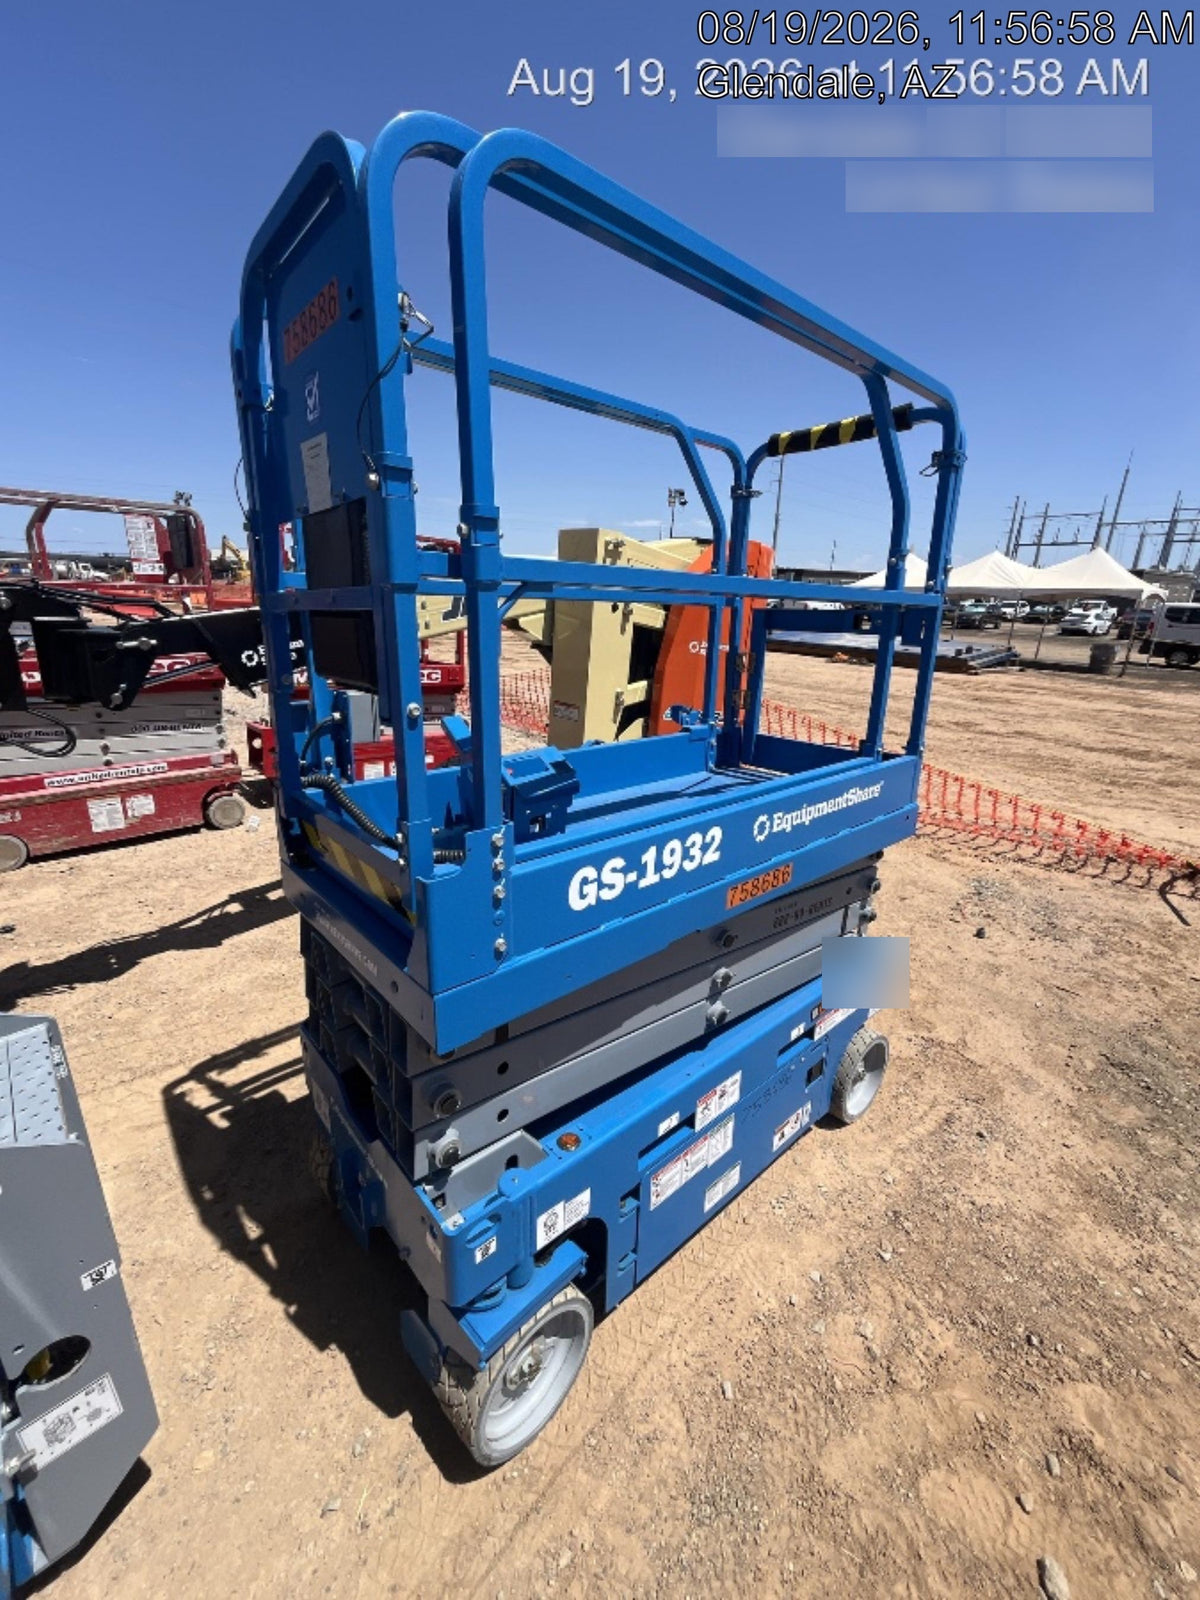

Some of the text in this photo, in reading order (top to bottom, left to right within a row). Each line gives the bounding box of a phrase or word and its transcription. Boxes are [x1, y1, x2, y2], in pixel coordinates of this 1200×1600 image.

[284, 280, 338, 362] 758686
[771, 781, 883, 832] EquipmentShare
[568, 825, 723, 912] GS-1932
[728, 866, 792, 906] 758686
